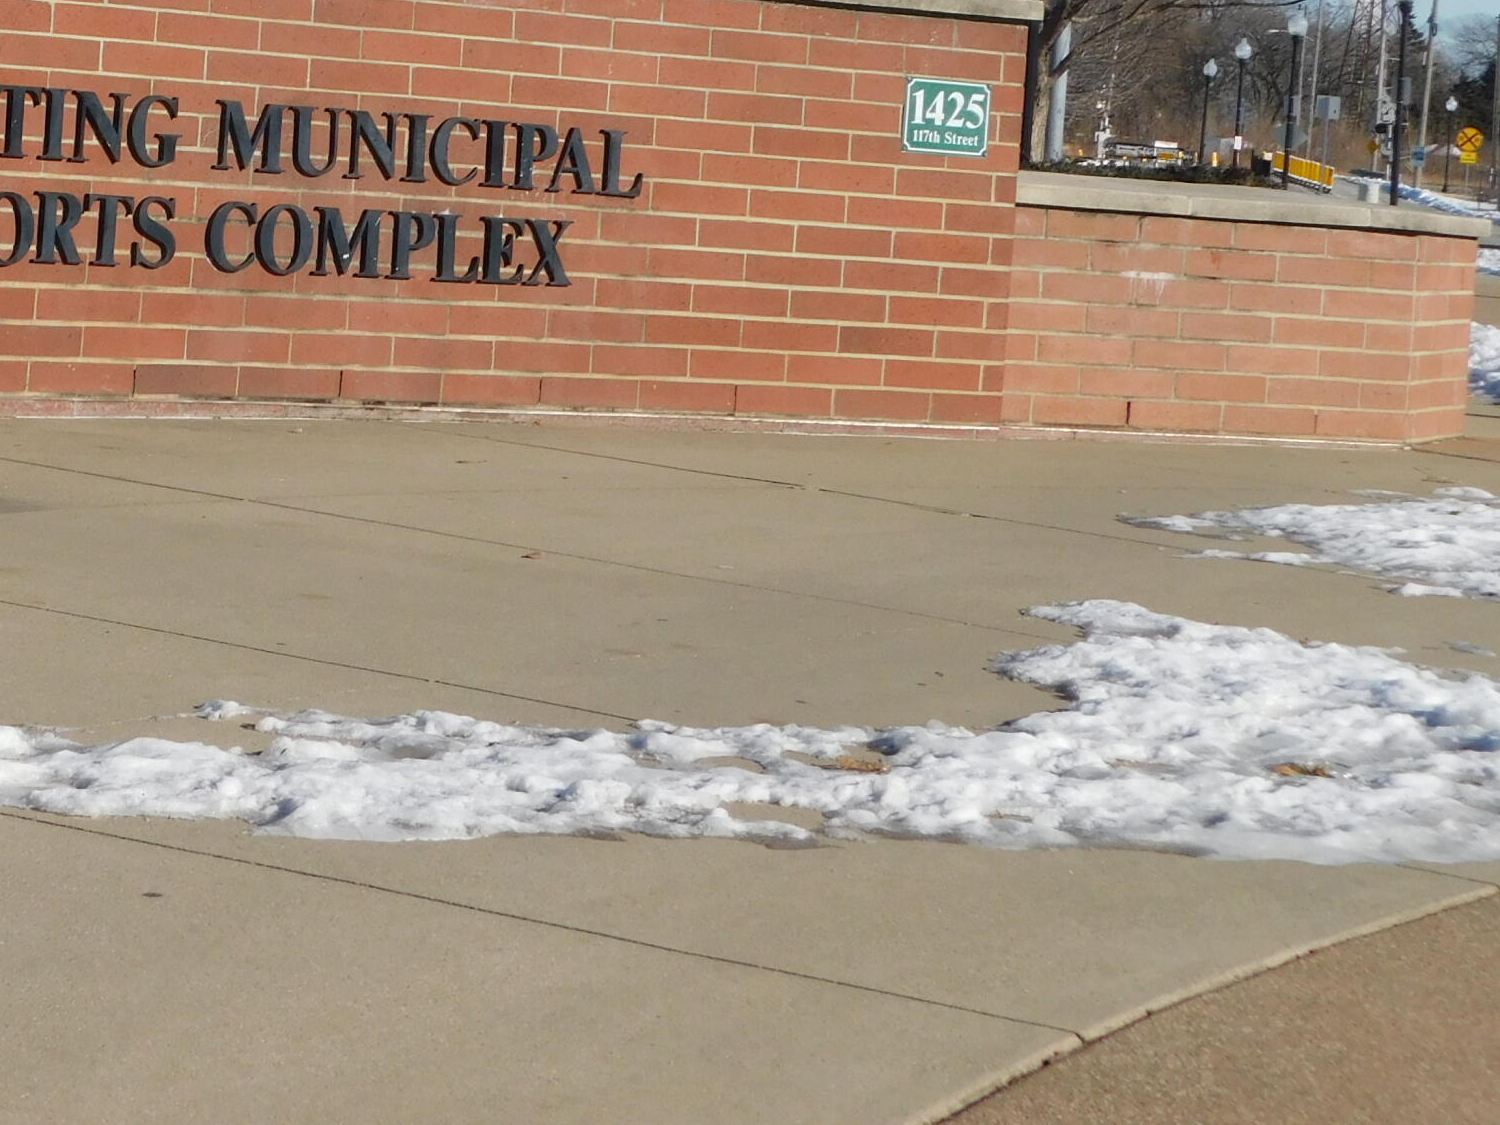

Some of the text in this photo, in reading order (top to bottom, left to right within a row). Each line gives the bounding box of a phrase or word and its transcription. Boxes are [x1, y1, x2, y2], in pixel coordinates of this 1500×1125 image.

[911, 89, 985, 129] 1425
[912, 129, 978, 146] 117th Street
[211, 99, 643, 197] MUNICIPAL
[204, 200, 573, 287] COMPLEX
